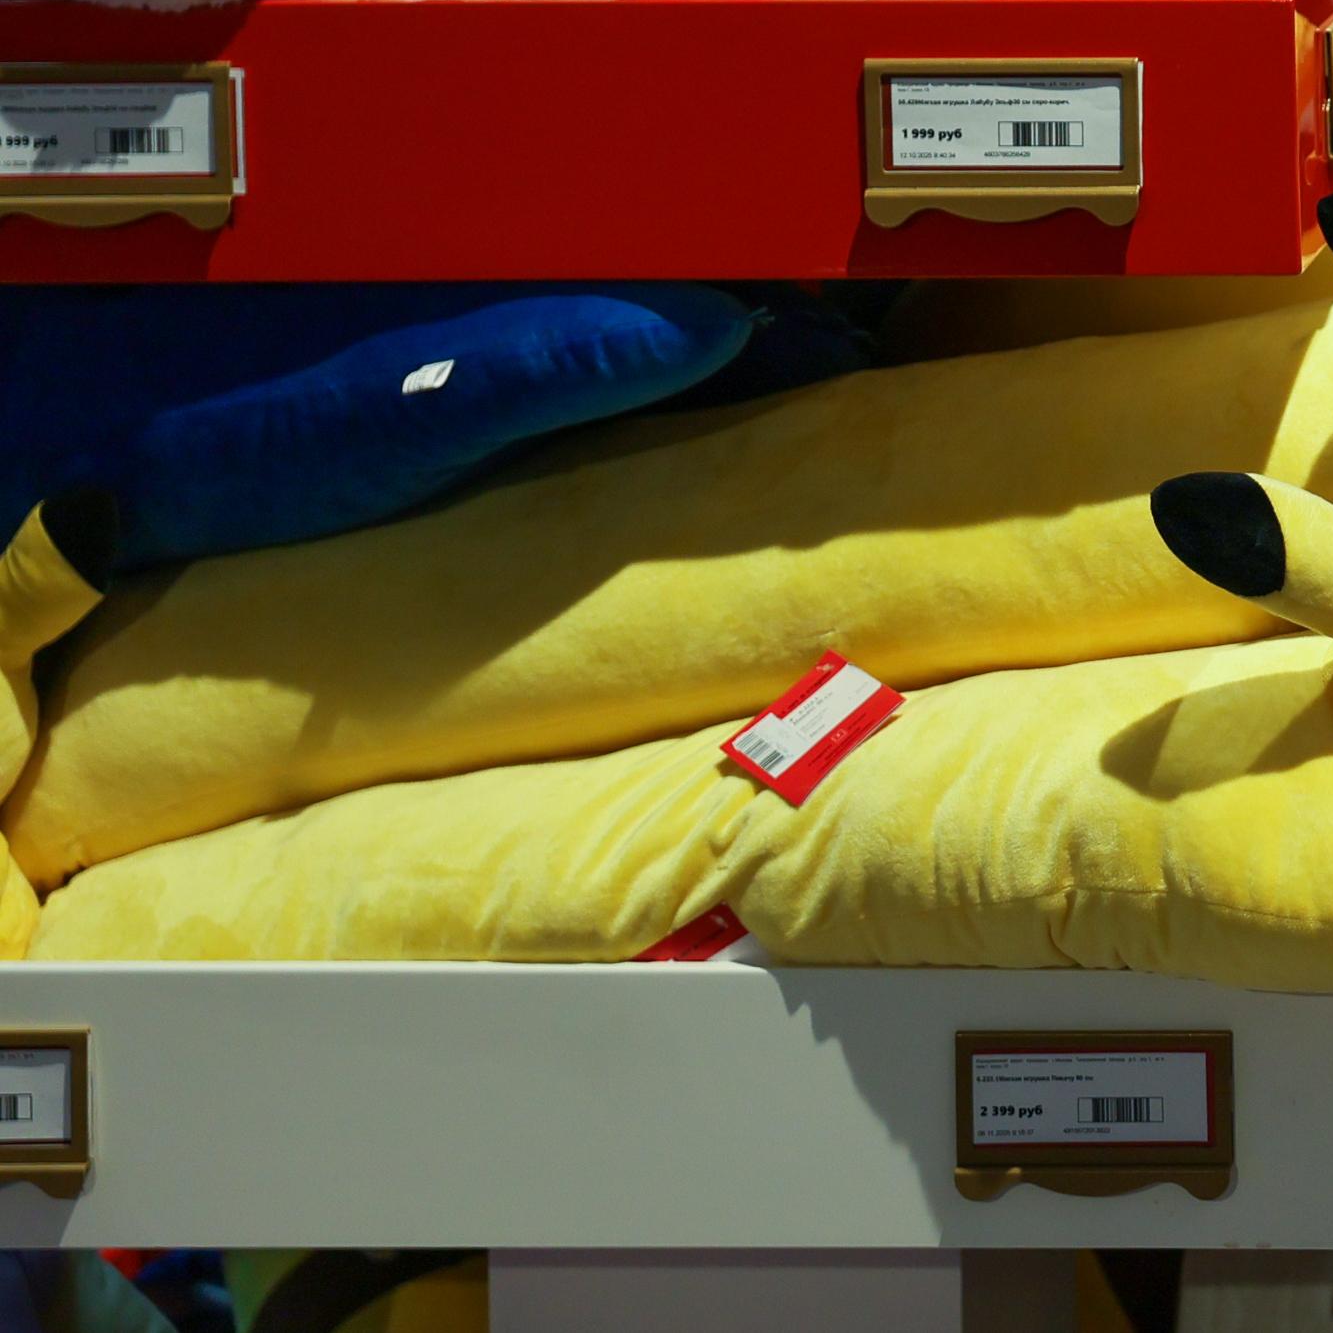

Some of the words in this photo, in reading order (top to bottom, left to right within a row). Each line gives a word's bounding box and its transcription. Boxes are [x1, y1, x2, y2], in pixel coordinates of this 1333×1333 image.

[5, 135, 30, 147] 999
[33, 134, 59, 150] руб
[902, 128, 908, 139] 1
[911, 128, 935, 139] 999
[937, 128, 963, 142] руб
[980, 1106, 988, 1117] 2
[991, 1105, 1015, 1116] 399
[1018, 1104, 1043, 1119] руб
